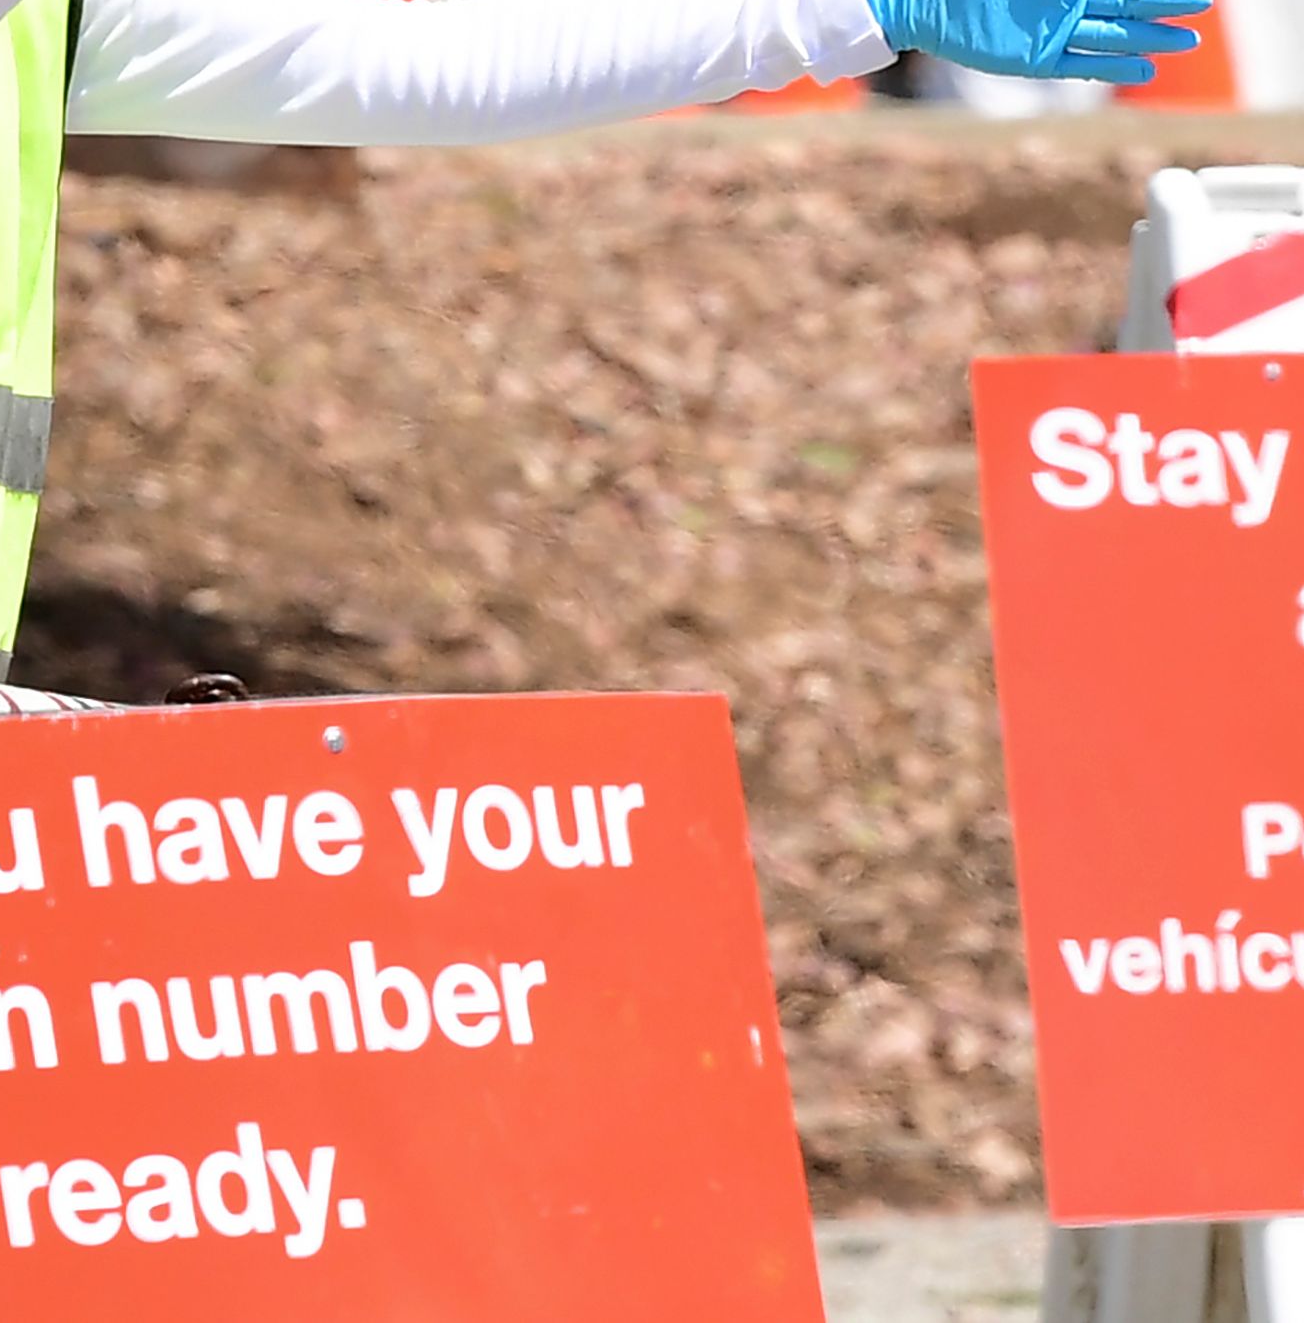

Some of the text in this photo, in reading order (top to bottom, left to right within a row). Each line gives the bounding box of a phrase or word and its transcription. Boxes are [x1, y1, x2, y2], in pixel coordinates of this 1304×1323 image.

[1029, 406, 1291, 528] Stay
[72, 775, 365, 888] have
[396, 782, 645, 898] your
[90, 940, 548, 1065] number
